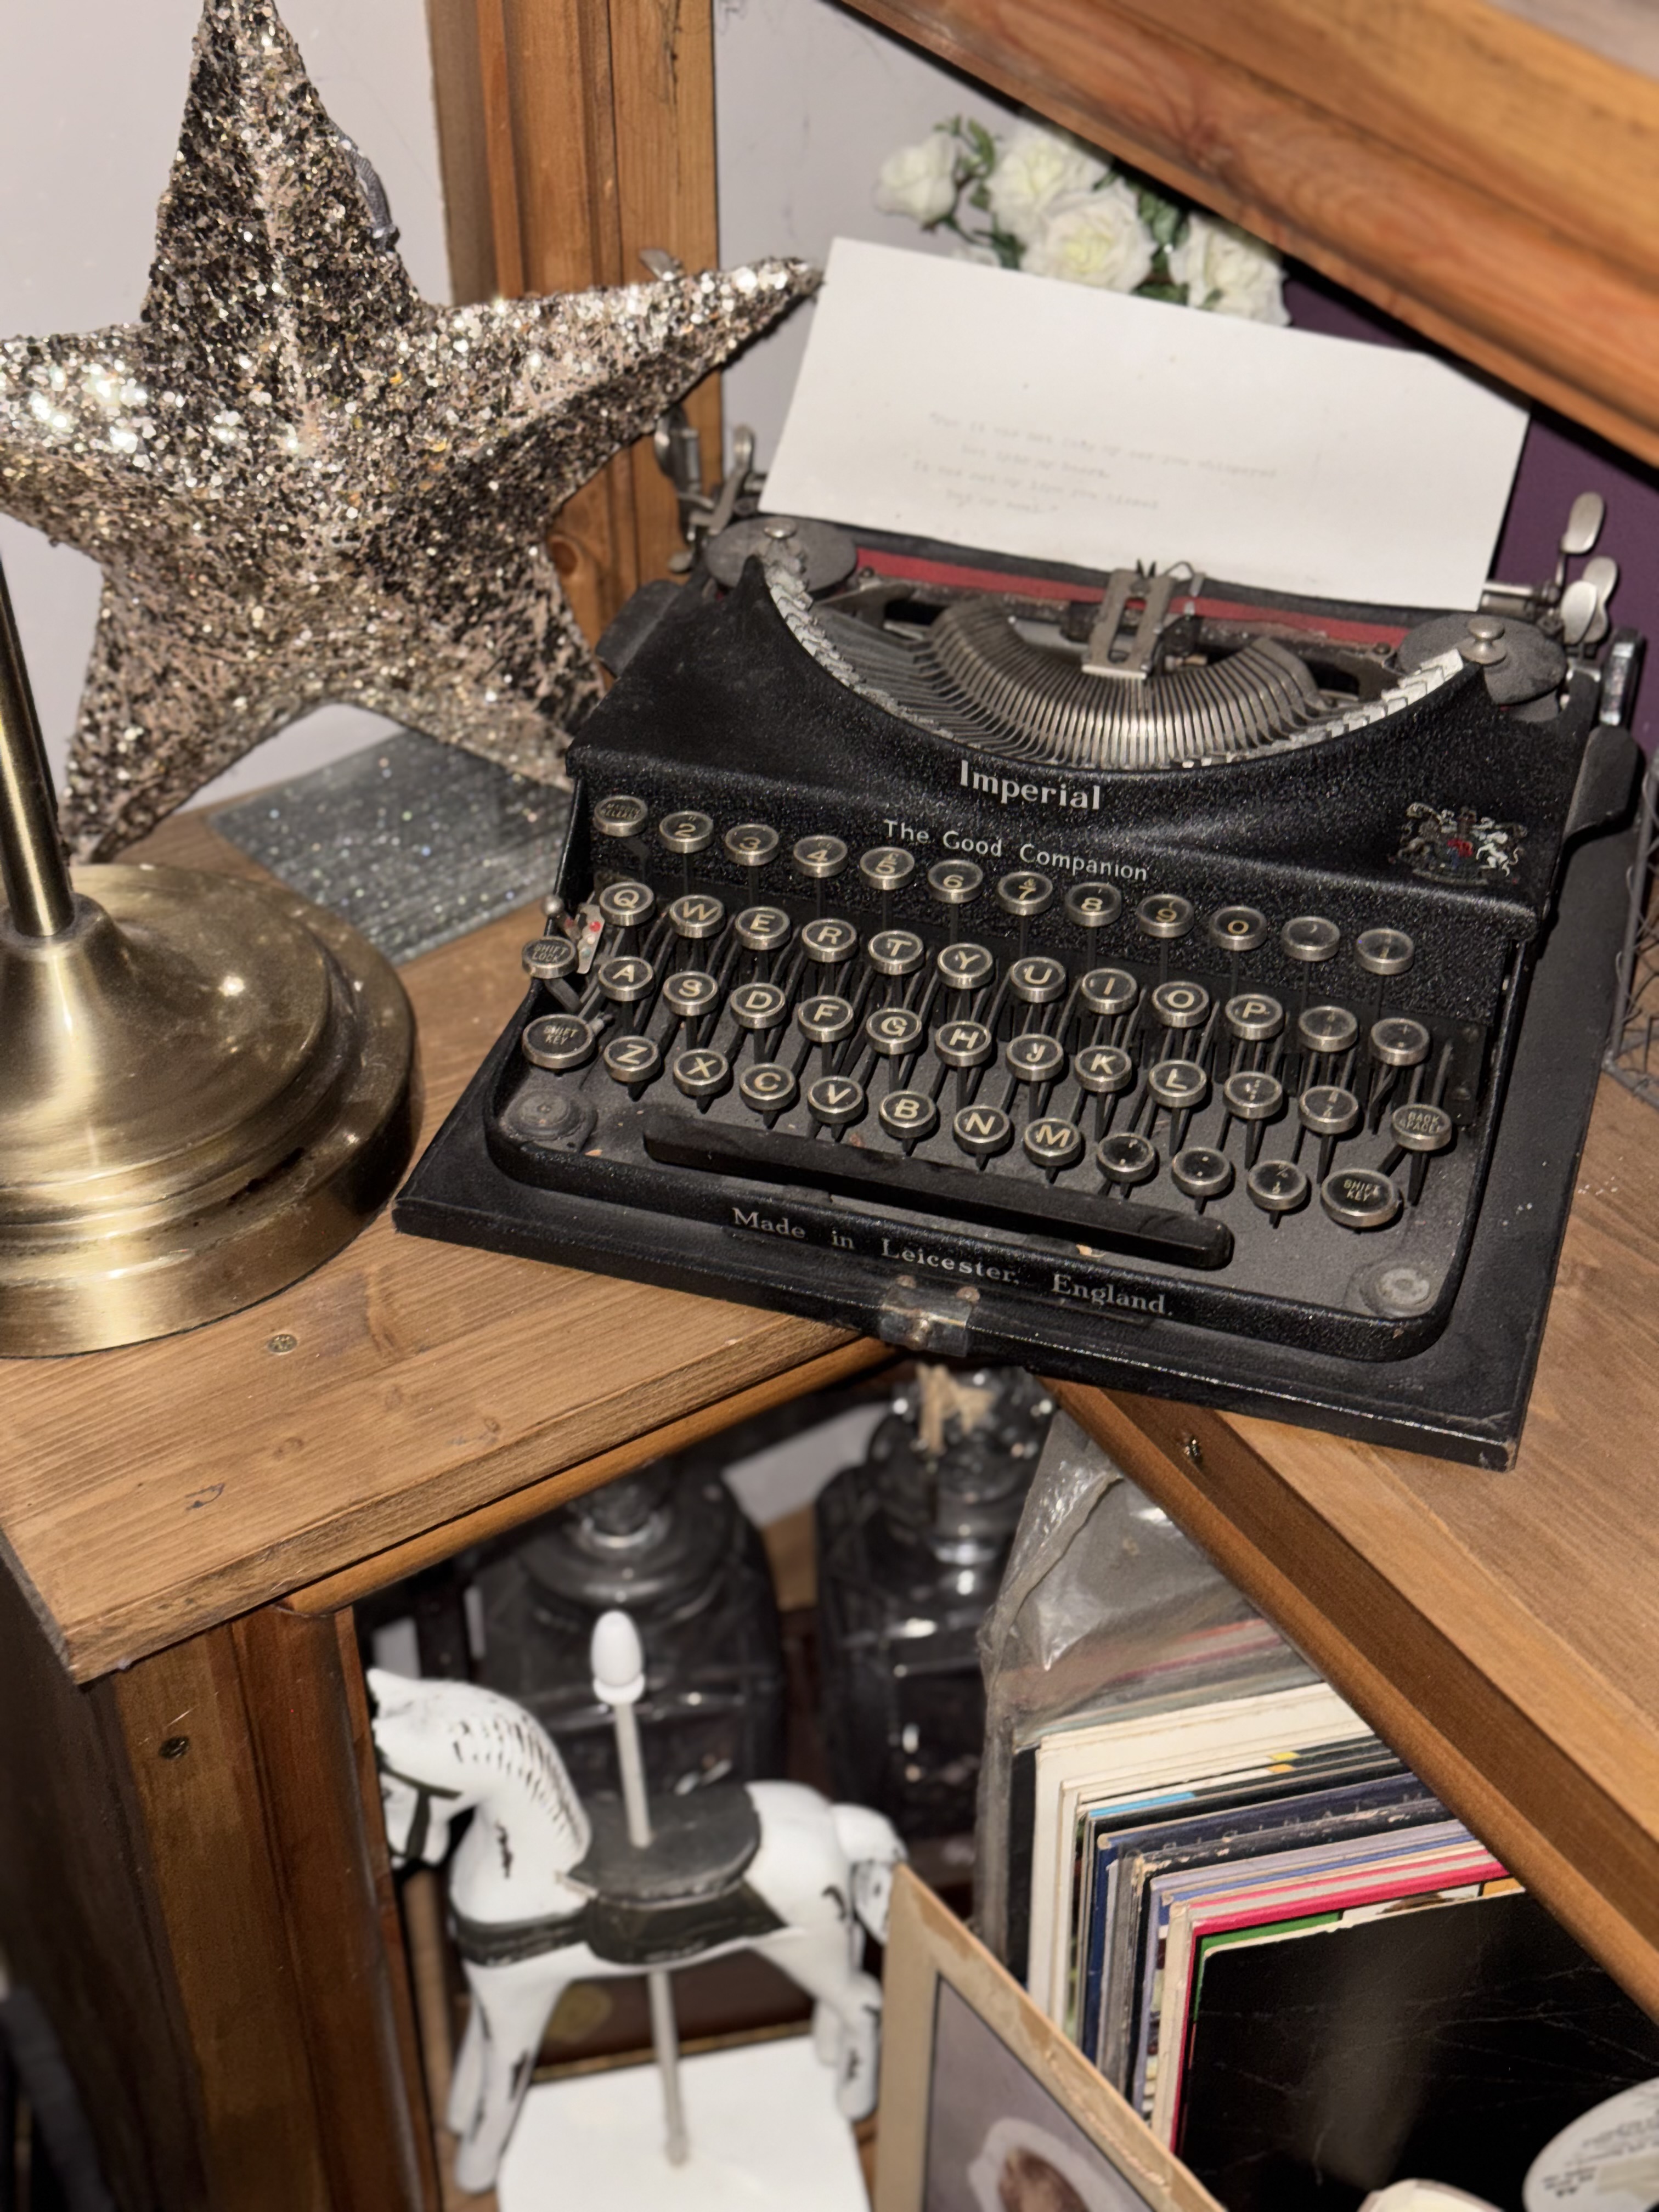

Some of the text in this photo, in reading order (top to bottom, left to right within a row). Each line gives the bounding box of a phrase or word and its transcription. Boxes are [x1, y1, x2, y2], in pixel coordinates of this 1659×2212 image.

[960, 759, 1101, 810] Imperial
[674, 823, 696, 838] 2
[739, 837, 761, 851] 3
[884, 819, 1148, 882] The Good Companion
[807, 849, 829, 863] 4
[875, 861, 897, 874] 5
[943, 874, 964, 889] 6
[613, 889, 640, 909] Q
[1018, 885, 1036, 901] 7
[681, 901, 719, 921] W
[1080, 897, 1103, 912] 8
[750, 913, 775, 933] E
[1155, 908, 1178, 923] 9
[817, 926, 842, 945] R
[888, 939, 912, 957] T
[957, 950, 981, 970] Y
[612, 964, 635, 984] A
[1024, 965, 1052, 984] U
[678, 979, 703, 997] S
[744, 991, 770, 1009] D
[812, 1004, 839, 1022] F
[1242, 1002, 1267, 1019] P
[881, 1015, 907, 1037] G
[545, 1034, 569, 1046] KEY
[949, 1028, 980, 1050] H
[616, 1044, 648, 1064] Z
[1025, 1043, 1046, 1063] J
[686, 1057, 718, 1079] X
[1090, 1054, 1117, 1075] K
[754, 1072, 782, 1091] C
[1165, 1068, 1188, 1091] L
[826, 1084, 852, 1105] V
[893, 1098, 920, 1119] B
[964, 1112, 995, 1135] N
[1035, 1125, 1073, 1148] M
[731, 1207, 807, 1239] Made
[831, 1230, 854, 1250] in
[1049, 1272, 1175, 1317] England.
